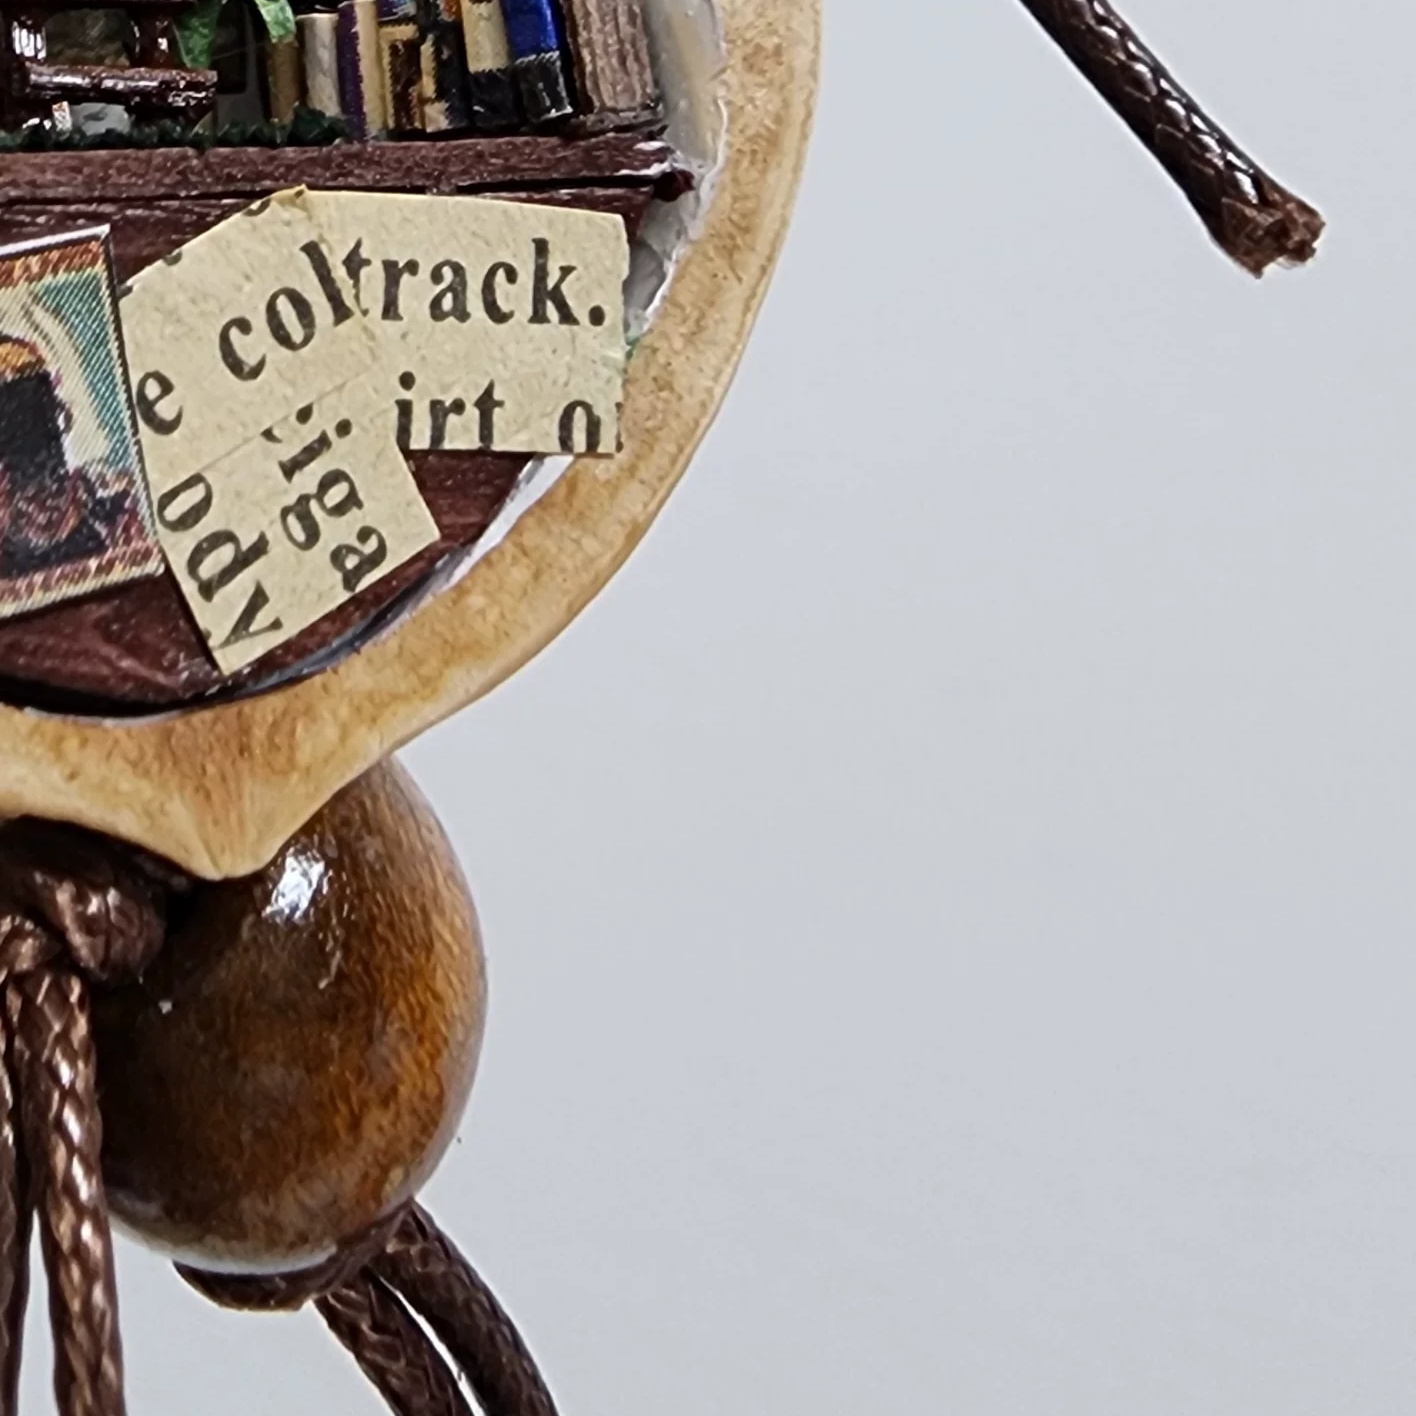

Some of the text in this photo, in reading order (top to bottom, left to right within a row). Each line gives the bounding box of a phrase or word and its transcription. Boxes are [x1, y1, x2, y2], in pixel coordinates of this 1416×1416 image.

[341, 236, 606, 327] track.
[135, 369, 184, 436] e
[394, 370, 624, 452] irt o
